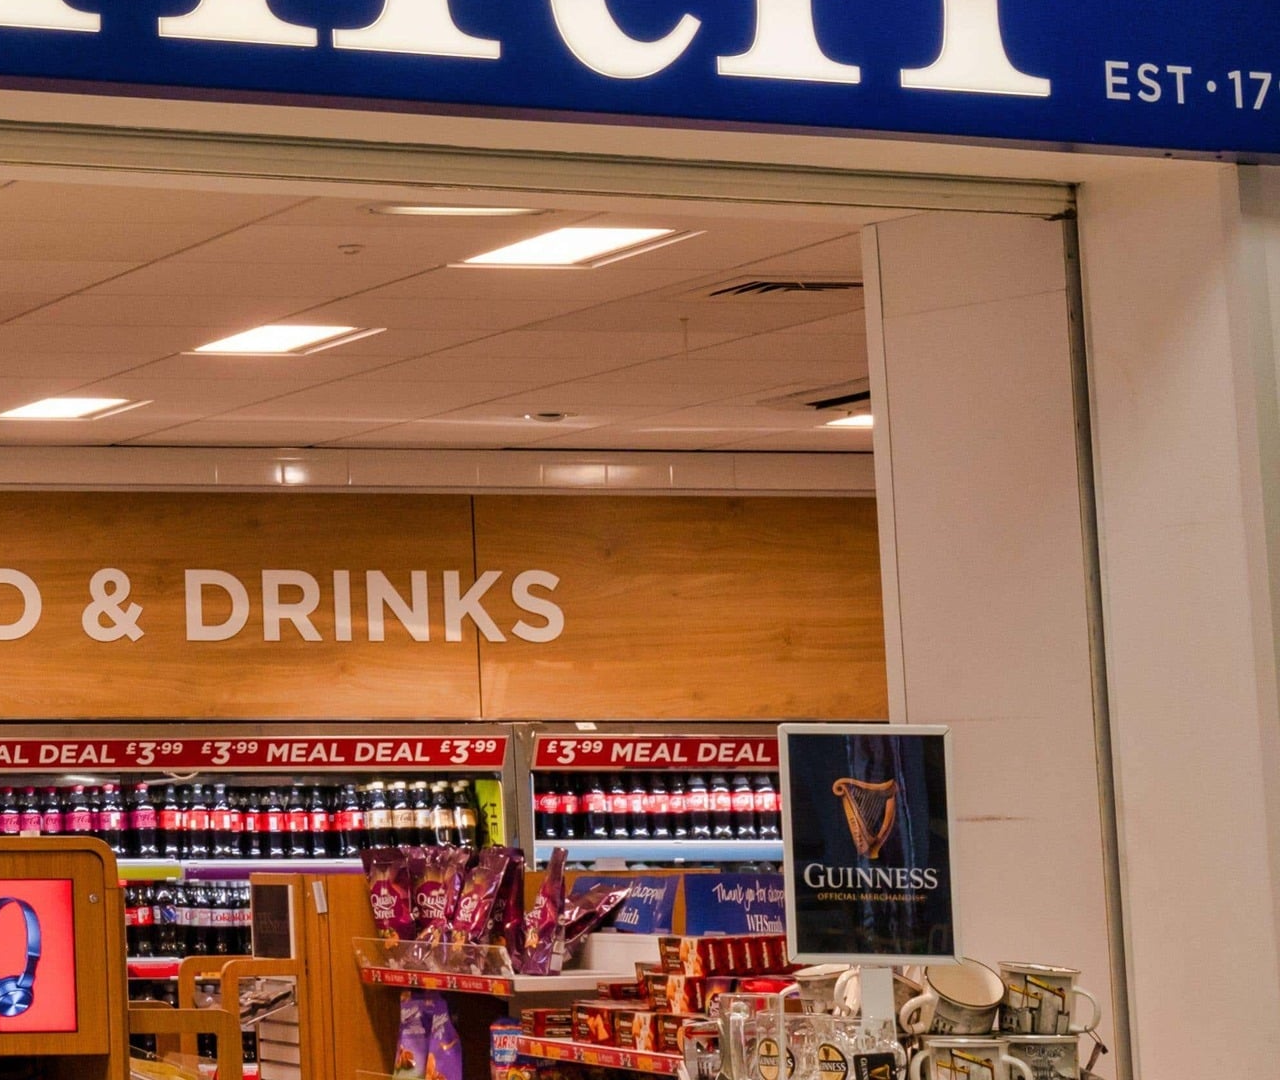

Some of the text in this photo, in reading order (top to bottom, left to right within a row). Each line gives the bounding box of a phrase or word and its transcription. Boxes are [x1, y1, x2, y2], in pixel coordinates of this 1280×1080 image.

[81, 567, 144, 642] &
[185, 568, 566, 644] DRINKS
[38, 744, 116, 764] DEAL
[266, 742, 345, 763] MEAL
[354, 742, 431, 762] DEAL
[610, 742, 688, 763] MEAL
[697, 742, 771, 762] DEAL
[803, 863, 939, 890] GUINNESS
[817, 892, 857, 901] OFFICIAL
